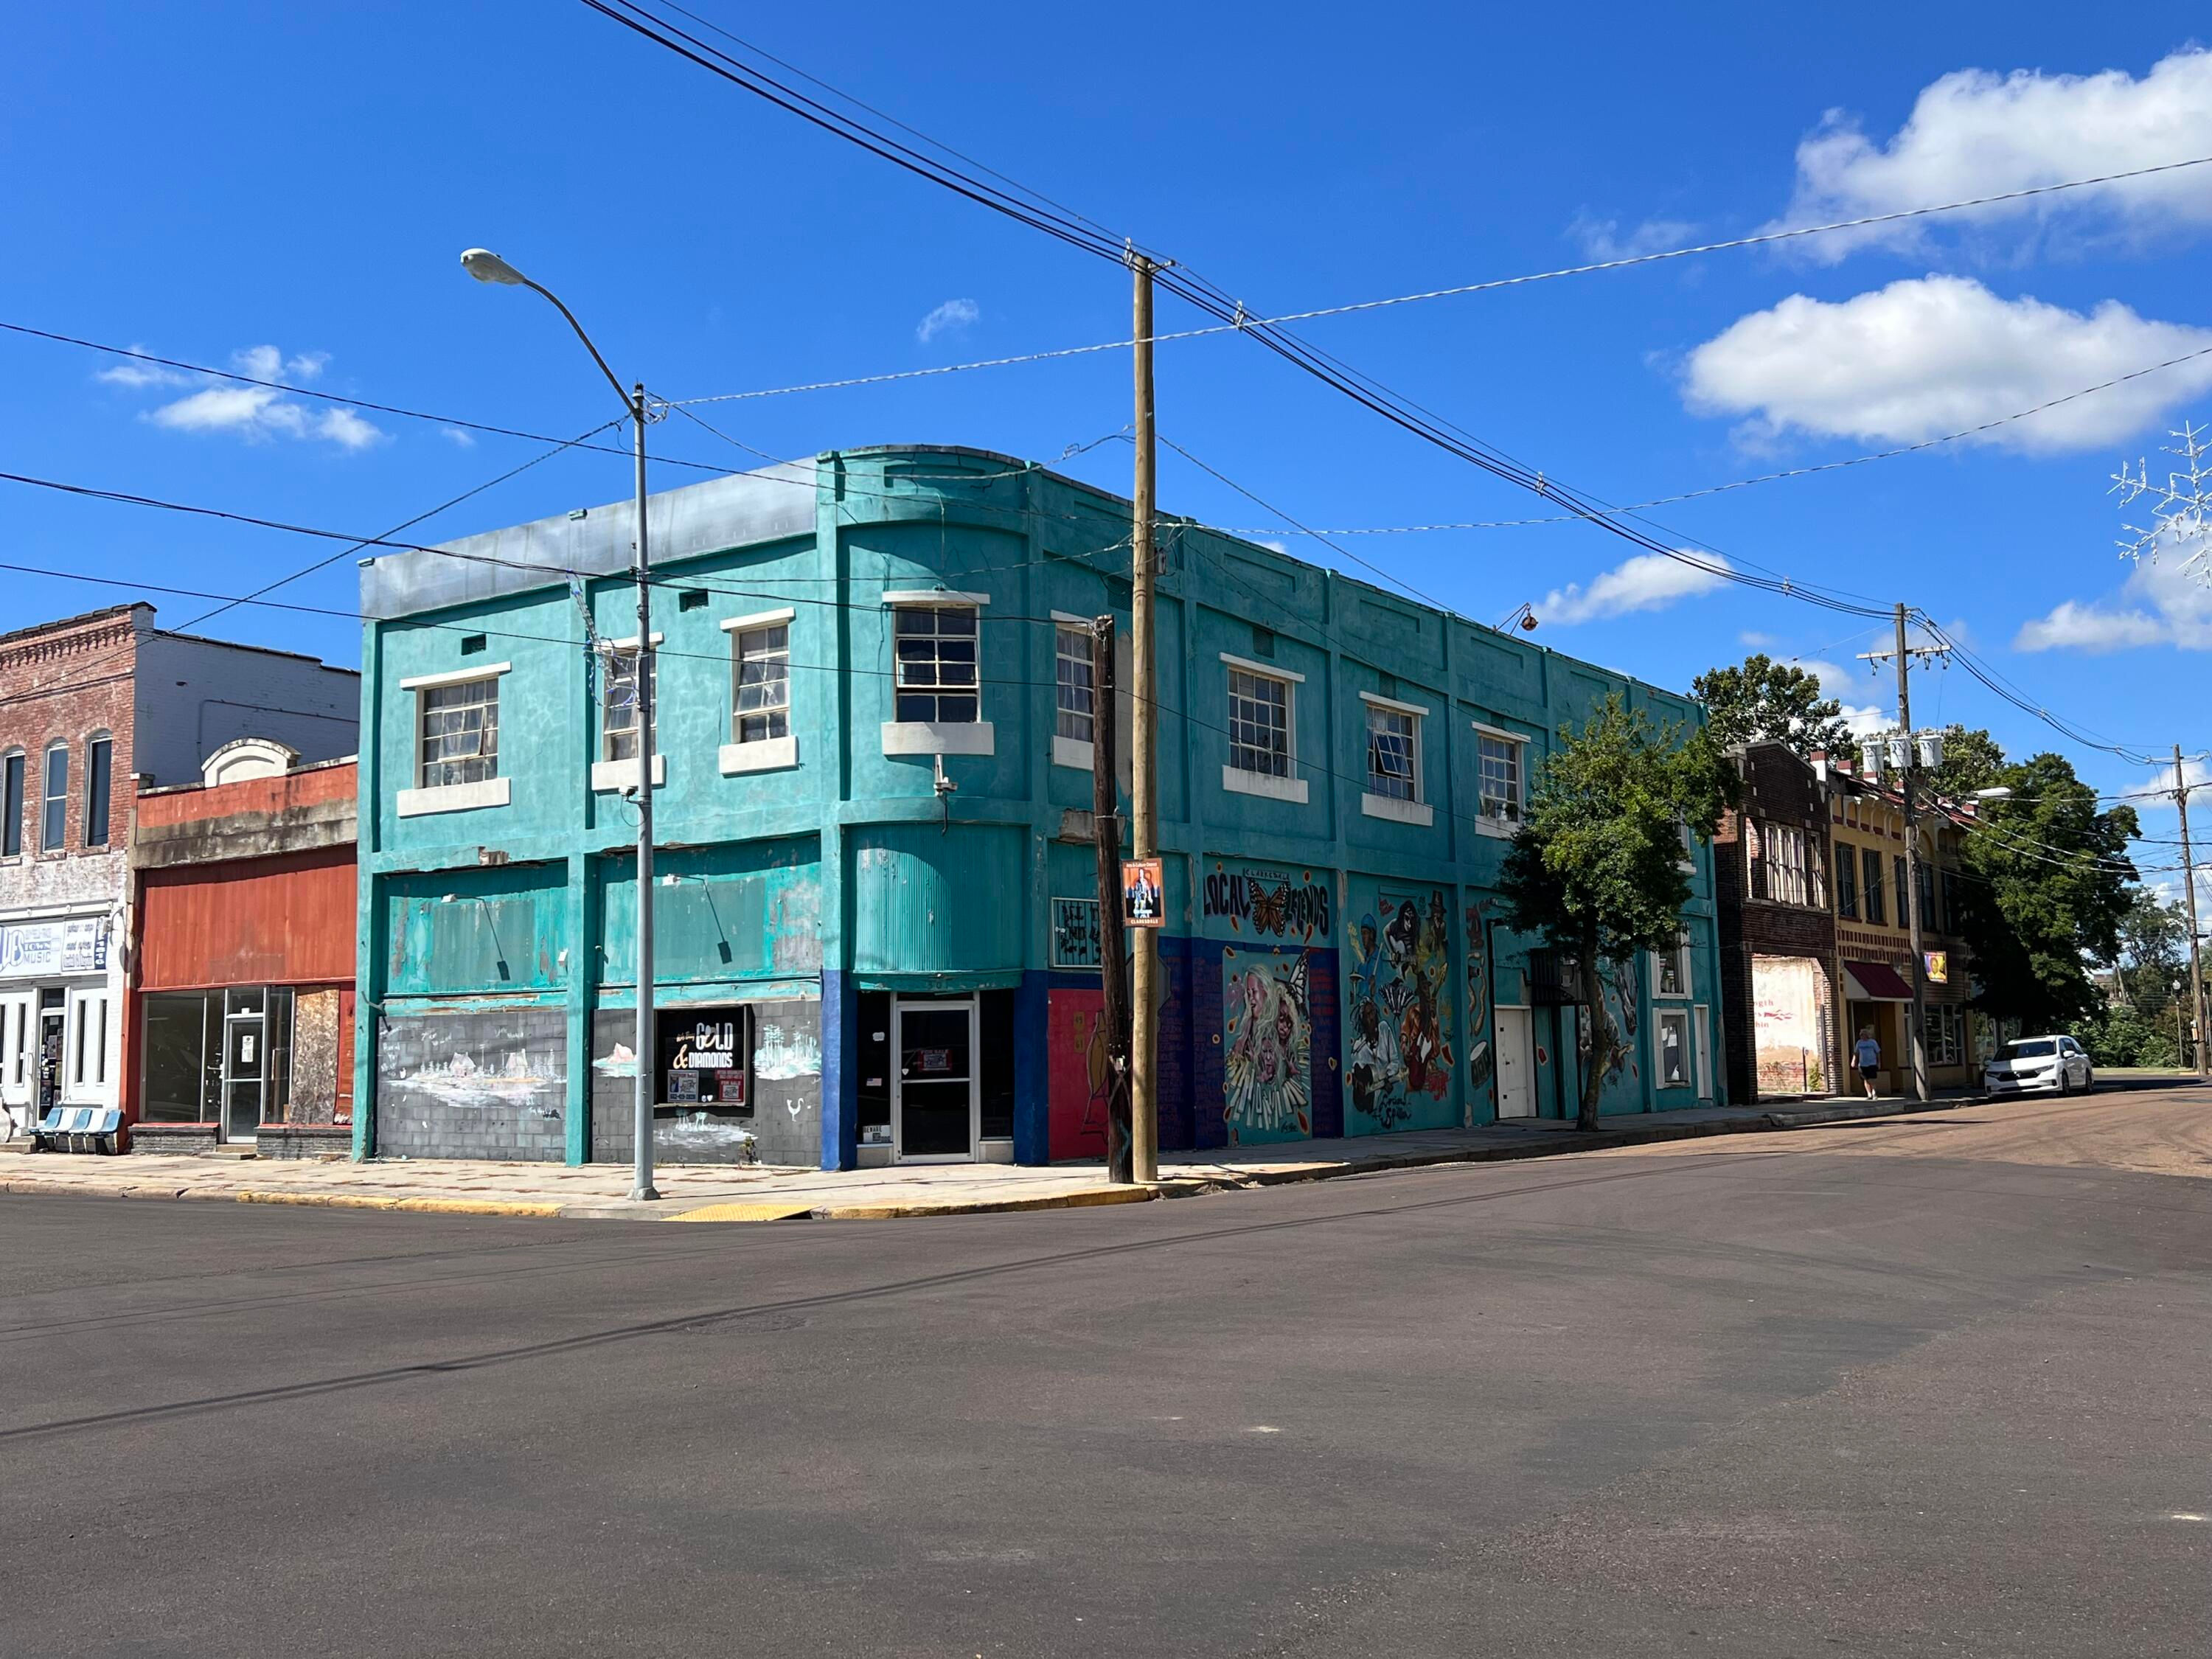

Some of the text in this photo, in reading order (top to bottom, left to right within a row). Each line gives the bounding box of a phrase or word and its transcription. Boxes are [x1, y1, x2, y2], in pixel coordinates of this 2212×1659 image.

[1203, 873, 1251, 920] LOCAL
[24, 943, 51, 951] TOWN
[24, 951, 52, 964] MUSIC
[696, 1022, 733, 1050] GOLD
[672, 1043, 733, 1069] & DIAMONDS
